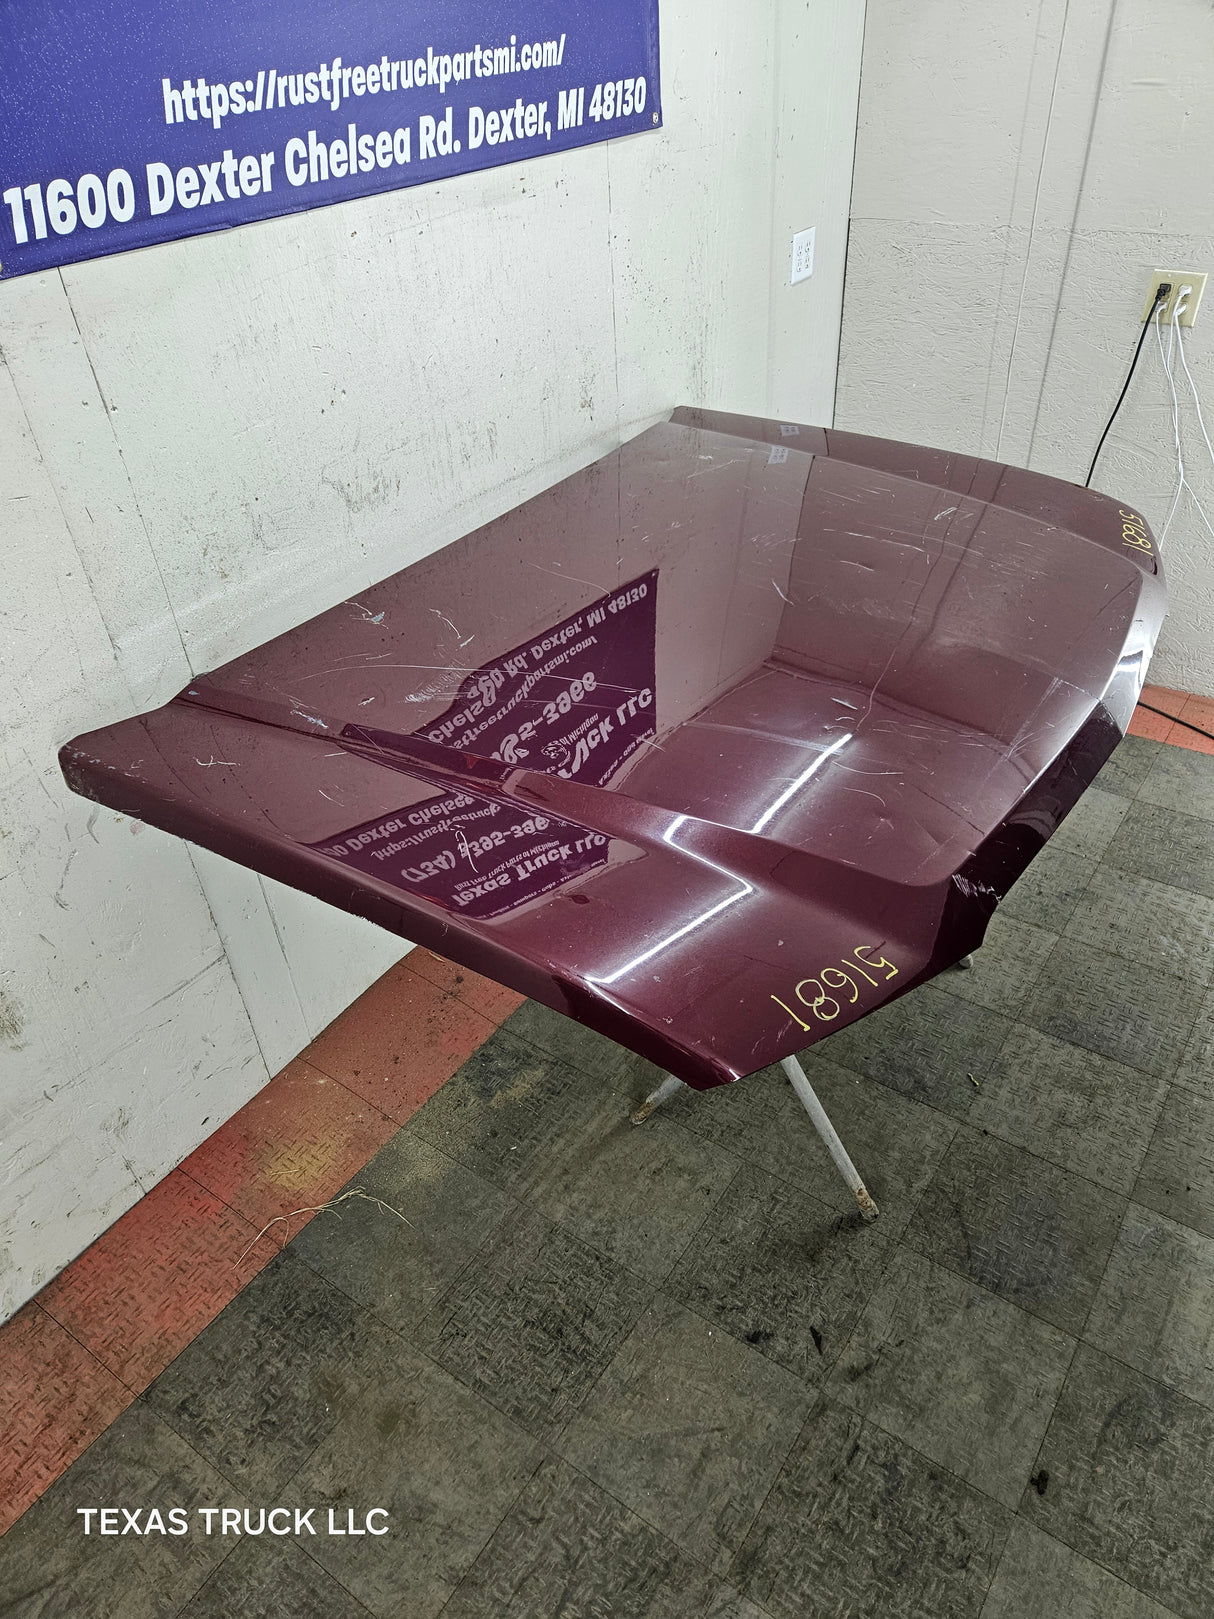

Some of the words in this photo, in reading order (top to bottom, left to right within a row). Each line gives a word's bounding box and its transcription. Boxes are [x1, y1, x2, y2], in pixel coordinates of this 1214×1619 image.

[162, 34, 566, 128] https://rustfreetruckpartsmi.com/
[3, 168, 136, 244] 11600
[147, 150, 275, 216] Dexter
[285, 125, 410, 187] Chelsea
[419, 114, 462, 160] Rd.
[468, 97, 551, 143] Dexter,
[557, 87, 585, 131] MI
[589, 75, 647, 122] 48130
